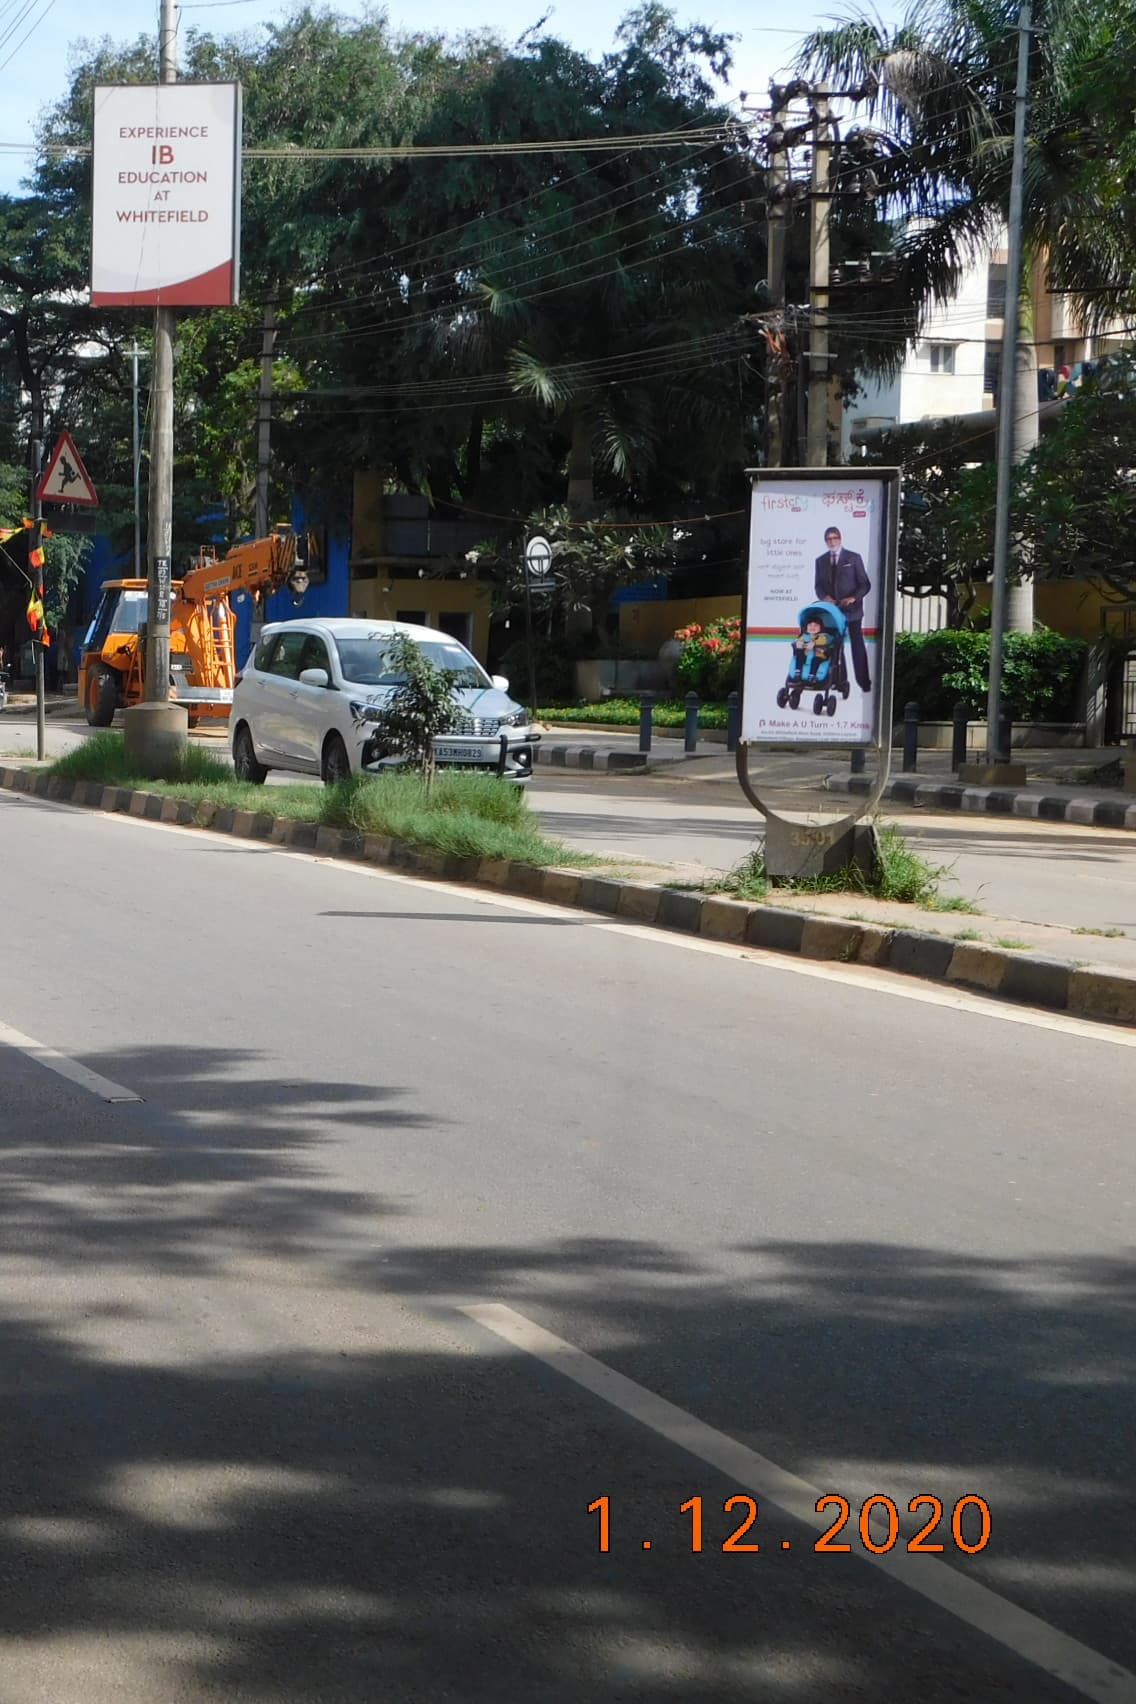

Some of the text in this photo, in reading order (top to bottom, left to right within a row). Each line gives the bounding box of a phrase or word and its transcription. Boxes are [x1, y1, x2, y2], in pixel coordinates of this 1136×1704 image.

[119, 126, 209, 139] EXPERIENCE
[151, 145, 175, 165] IB
[118, 170, 208, 184] EDUCATION
[154, 190, 171, 201] AT
[116, 210, 209, 223] WHITEFIELD
[768, 719, 791, 728] Make
[792, 720, 799, 728] A
[801, 720, 807, 728] U
[810, 720, 828, 729] Turn
